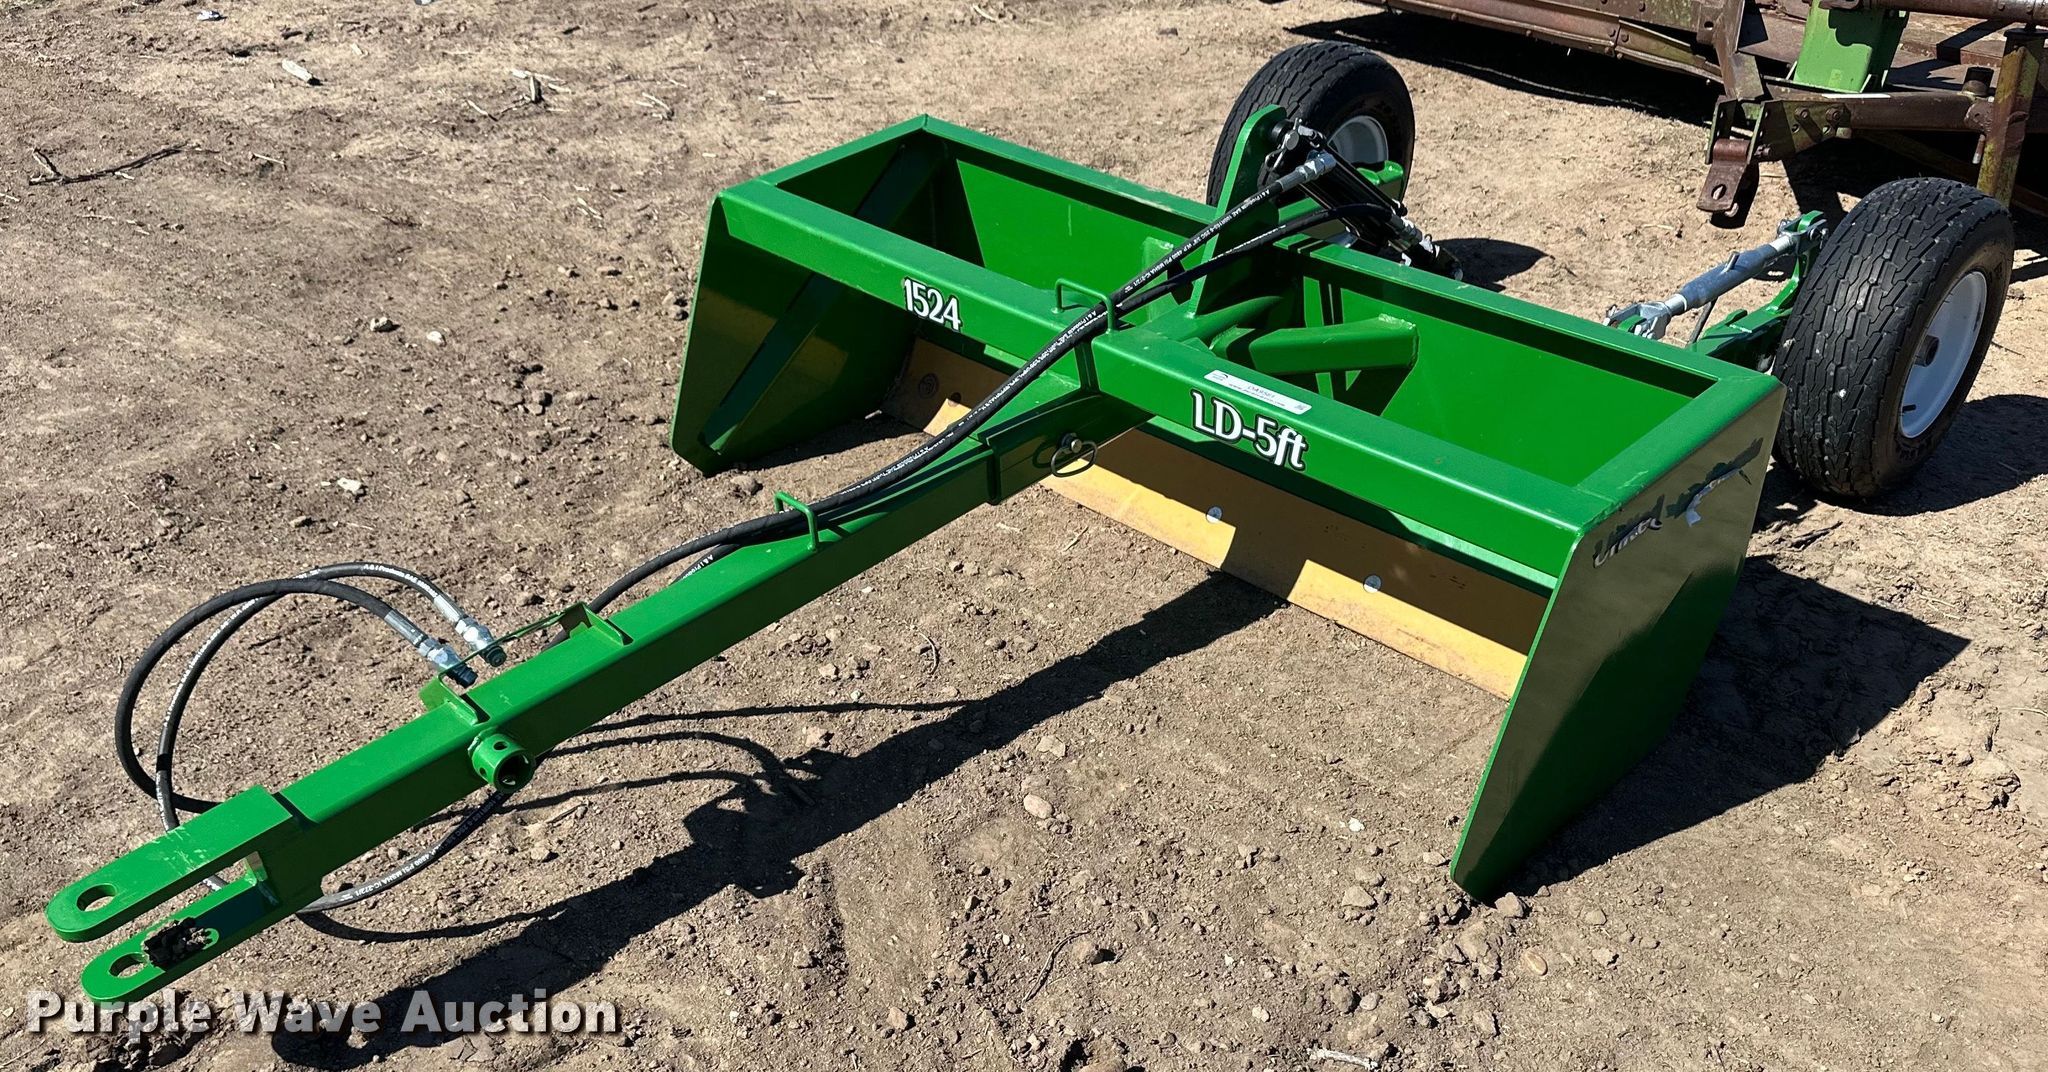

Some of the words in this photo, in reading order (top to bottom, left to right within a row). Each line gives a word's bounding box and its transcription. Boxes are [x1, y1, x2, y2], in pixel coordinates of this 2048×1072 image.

[905, 277, 963, 331] 1524
[1066, 318, 1087, 335] Products
[1191, 391, 1308, 470] LD-5ft
[401, 863, 414, 873] PSI
[381, 870, 403, 885] MSHA
